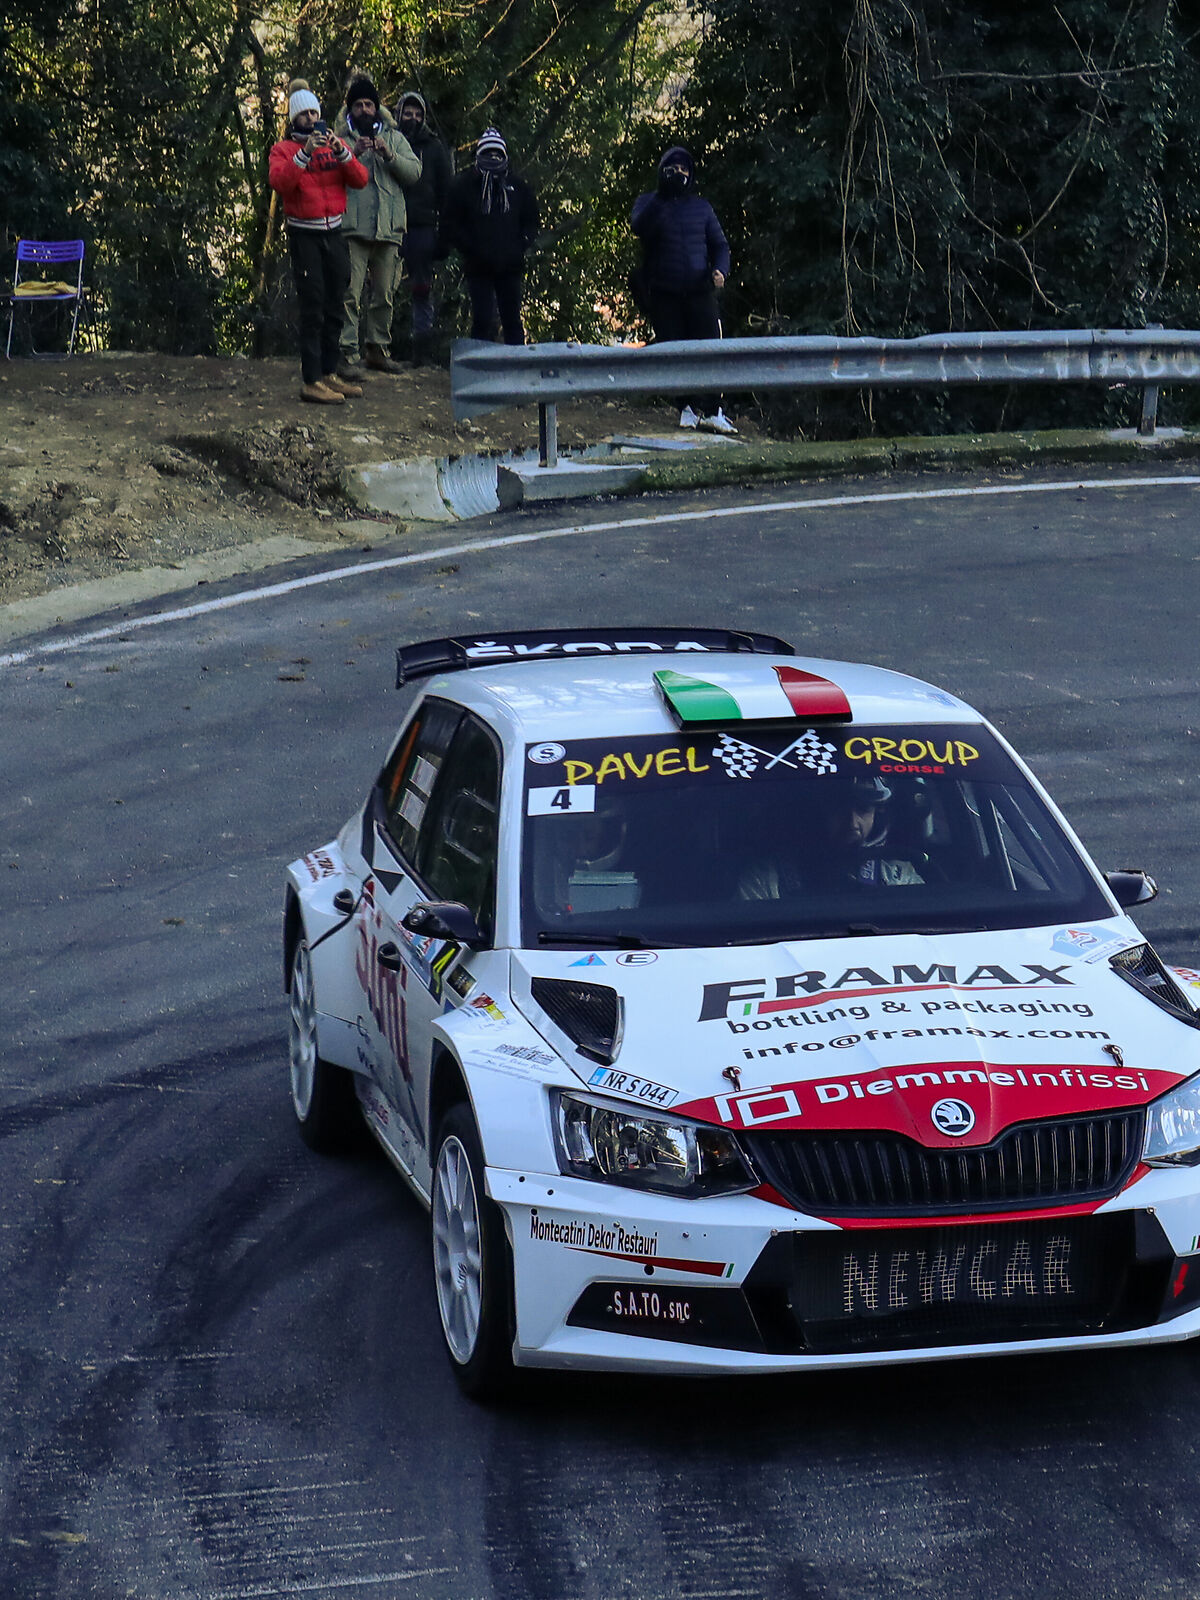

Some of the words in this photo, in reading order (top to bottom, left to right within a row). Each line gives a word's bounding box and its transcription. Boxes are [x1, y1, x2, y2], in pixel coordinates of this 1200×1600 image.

[563, 746, 711, 786] PAVEL
[844, 736, 980, 766] GROUP
[879, 764, 945, 775] CORSE
[550, 788, 573, 811] 4
[624, 953, 651, 964] E
[697, 963, 1077, 1023] FRAMAX
[726, 1002, 870, 1035] bottling
[880, 999, 911, 1014] &
[921, 999, 1095, 1018] packaging
[742, 1025, 1112, 1060] info@framax.com
[603, 1071, 625, 1090] NR
[626, 1078, 641, 1094] S
[638, 1082, 671, 1104] 044
[815, 1066, 1151, 1104] DiemmeInfissi
[530, 1215, 587, 1246] Montecatini
[587, 1224, 616, 1250] Dekor
[617, 1226, 658, 1257] Restauri
[843, 1235, 1075, 1313] NEWCAR
